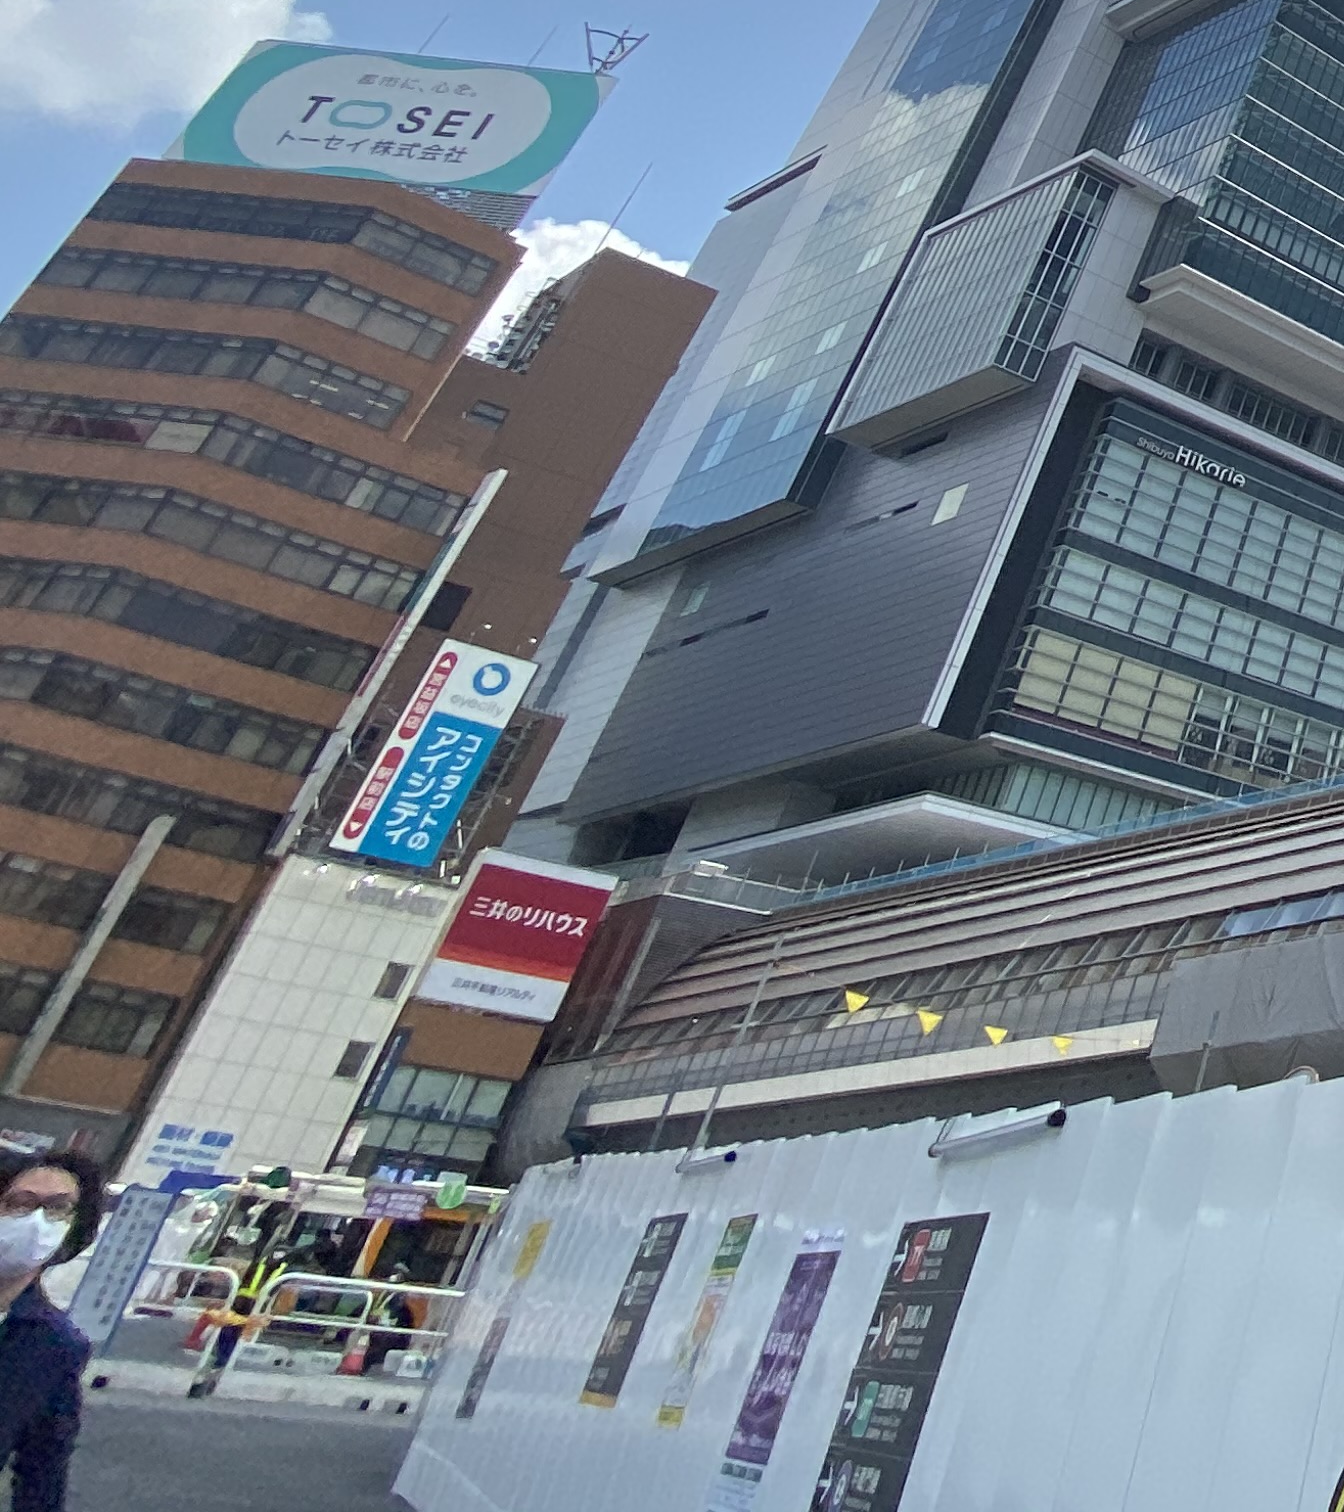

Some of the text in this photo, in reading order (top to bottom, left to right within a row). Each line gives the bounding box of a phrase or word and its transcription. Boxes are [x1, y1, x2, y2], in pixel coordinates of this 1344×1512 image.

[300, 95, 495, 140] TOSEI
[276, 130, 469, 164] トーセイ株式会社
[1136, 436, 1246, 488] Shibuya Hikarie
[449, 693, 506, 717] eyecity
[384, 726, 462, 846] アイシティ
[407, 734, 484, 851] コンタクトの
[468, 896, 589, 938] 三井のリハウス
